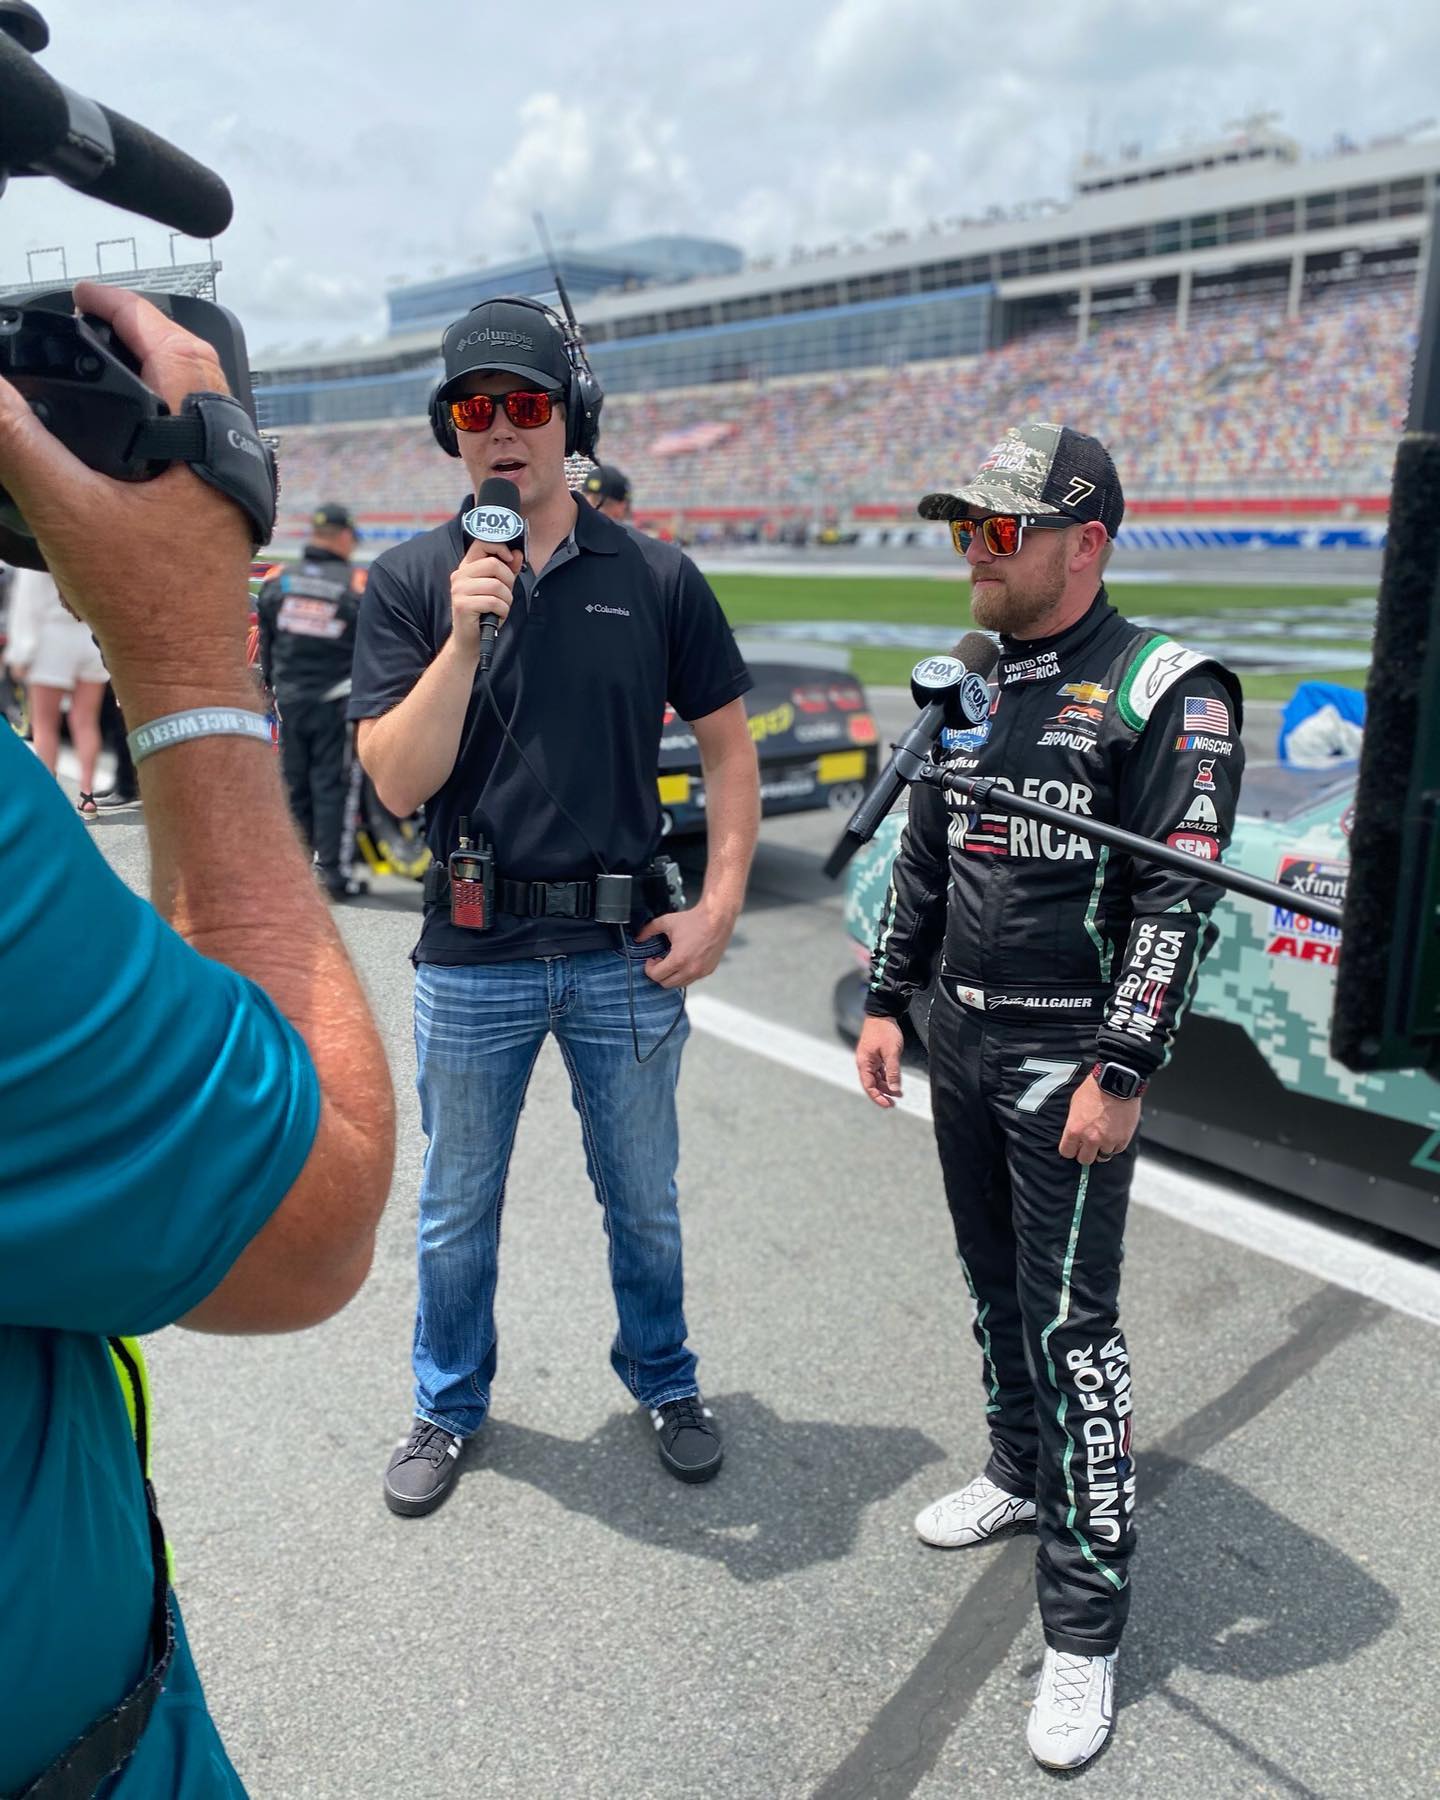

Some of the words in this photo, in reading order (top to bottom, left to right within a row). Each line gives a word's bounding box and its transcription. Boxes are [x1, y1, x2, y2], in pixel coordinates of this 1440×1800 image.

[467, 328, 533, 346] Columbia
[1062, 476, 1096, 507] 7
[475, 526, 511, 536] SPORTS
[476, 512, 511, 529] FOX
[594, 603, 630, 617] Columbia
[923, 661, 957, 678] FOX
[1003, 658, 1036, 674] UNITED
[1036, 651, 1059, 666] FOR
[920, 671, 950, 683] SPORTS
[968, 679, 988, 713] FOX
[151, 718, 199, 744] WEEK
[1036, 731, 1098, 753] BRANDT
[137, 734, 150, 751] 15
[1192, 735, 1233, 757] NASCAR
[1023, 778, 1094, 815] FOR
[1175, 821, 1218, 833] AXALTA
[1175, 838, 1211, 860] SEM
[1291, 872, 1348, 898] xfinit
[1129, 922, 1158, 969] FOR
[1023, 997, 1093, 1009] ALLGAIER
[1014, 1055, 1083, 1115] 7
[1066, 1342, 1108, 1413] FOR
[1082, 1416, 1121, 1543] UNITED
